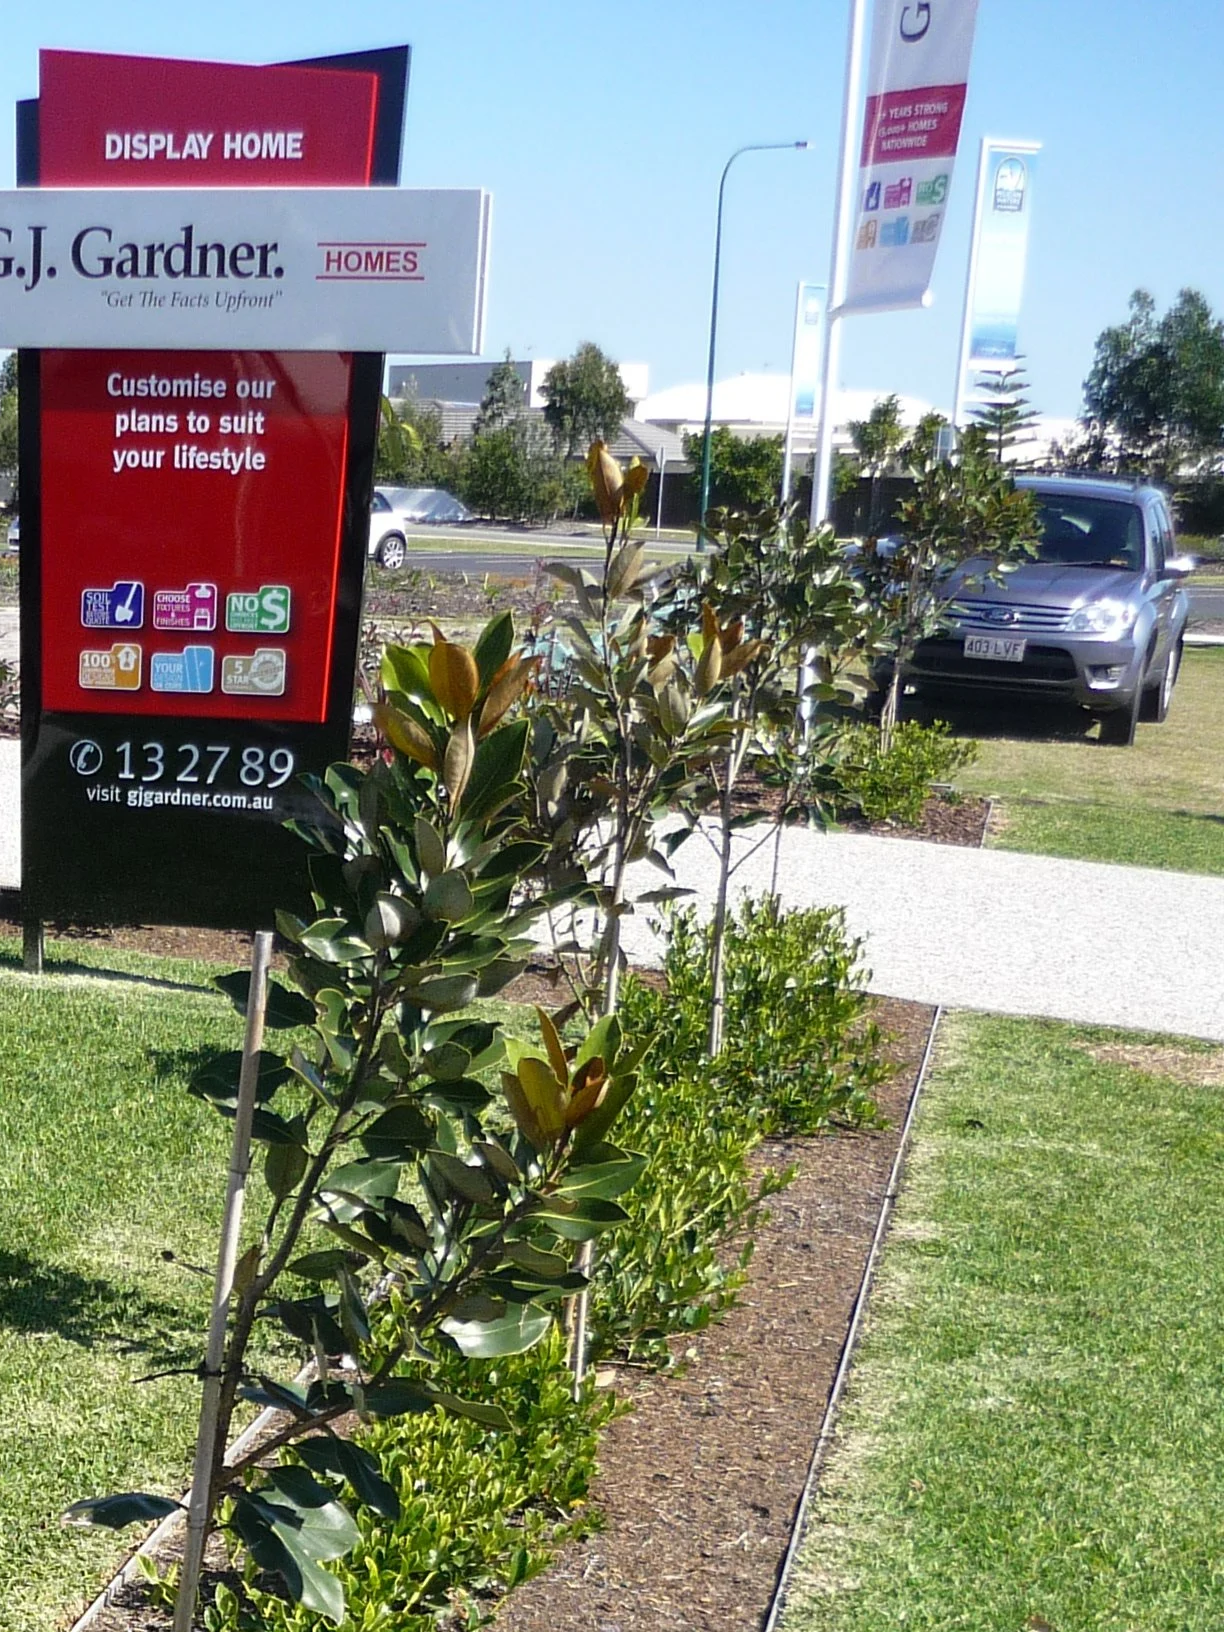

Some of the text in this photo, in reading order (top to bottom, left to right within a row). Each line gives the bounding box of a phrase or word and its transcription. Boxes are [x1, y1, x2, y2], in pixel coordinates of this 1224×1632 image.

[889, 105, 912, 119] YEARS
[914, 102, 948, 116] STRONG
[907, 119, 937, 132] HOMES
[105, 133, 303, 160] DISPLAY HOME
[881, 135, 927, 151] NATIONWIDE
[71, 224, 284, 279] Gardner.
[325, 250, 418, 273] HOMES
[101, 290, 283, 313] "Get The Facts Upfront"
[107, 372, 276, 398] Customise our
[115, 407, 264, 437] plans to suit
[113, 444, 266, 475] your lifestyle
[86, 592, 111, 603] SOIL
[86, 600, 111, 611] TEST
[157, 594, 190, 603] CHOOSE
[231, 595, 259, 612] NO
[157, 603, 190, 612] FIXTURES
[157, 617, 190, 626] FINISHES
[966, 639, 1021, 657] 403 LVF
[83, 653, 111, 668] 100
[154, 662, 183, 673] YOUR
[235, 660, 244, 674] 5
[227, 674, 249, 685] STAR
[116, 741, 294, 789] 13 27 89
[86, 784, 273, 810] visit gjgardner.com.au
